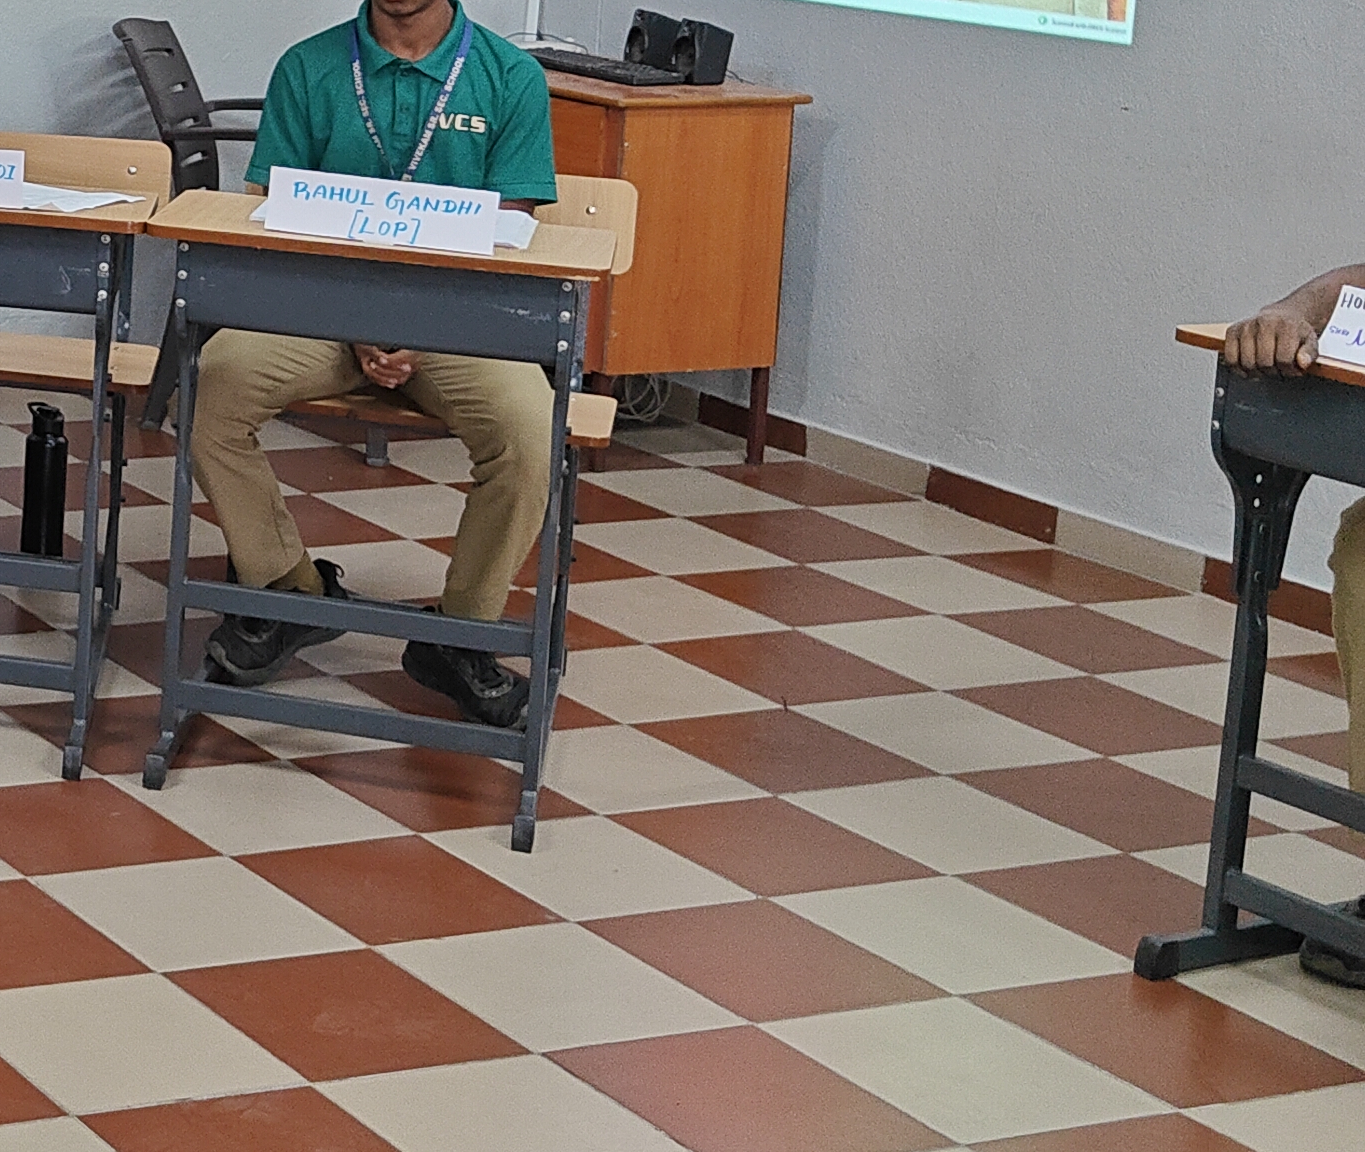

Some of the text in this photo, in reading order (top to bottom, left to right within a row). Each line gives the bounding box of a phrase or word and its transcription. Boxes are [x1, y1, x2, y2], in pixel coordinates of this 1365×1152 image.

[407, 56, 464, 172] VIVEKAM SR. SEC. SCHOOL
[438, 112, 486, 133] VCS
[293, 181, 482, 215] RAHUL GANDHI
[348, 209, 421, 244] [LOP]
[1340, 293, 1365, 310] HO
